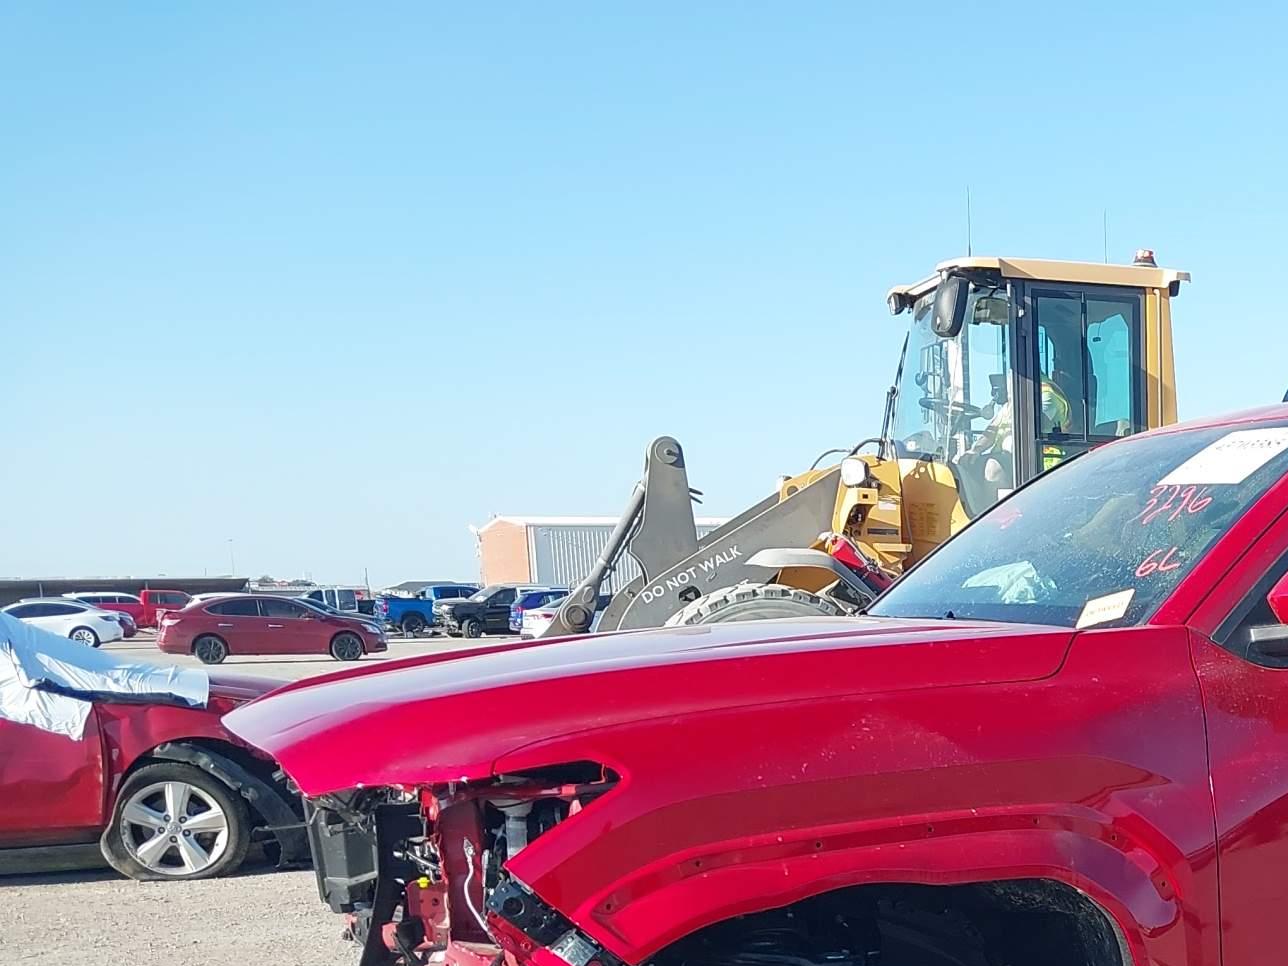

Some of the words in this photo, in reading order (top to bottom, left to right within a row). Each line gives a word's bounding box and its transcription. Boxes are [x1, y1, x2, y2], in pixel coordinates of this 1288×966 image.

[1142, 485, 1213, 525] 3296
[641, 585, 665, 604] DO
[666, 566, 697, 591] NOT
[698, 545, 743, 573] WALK
